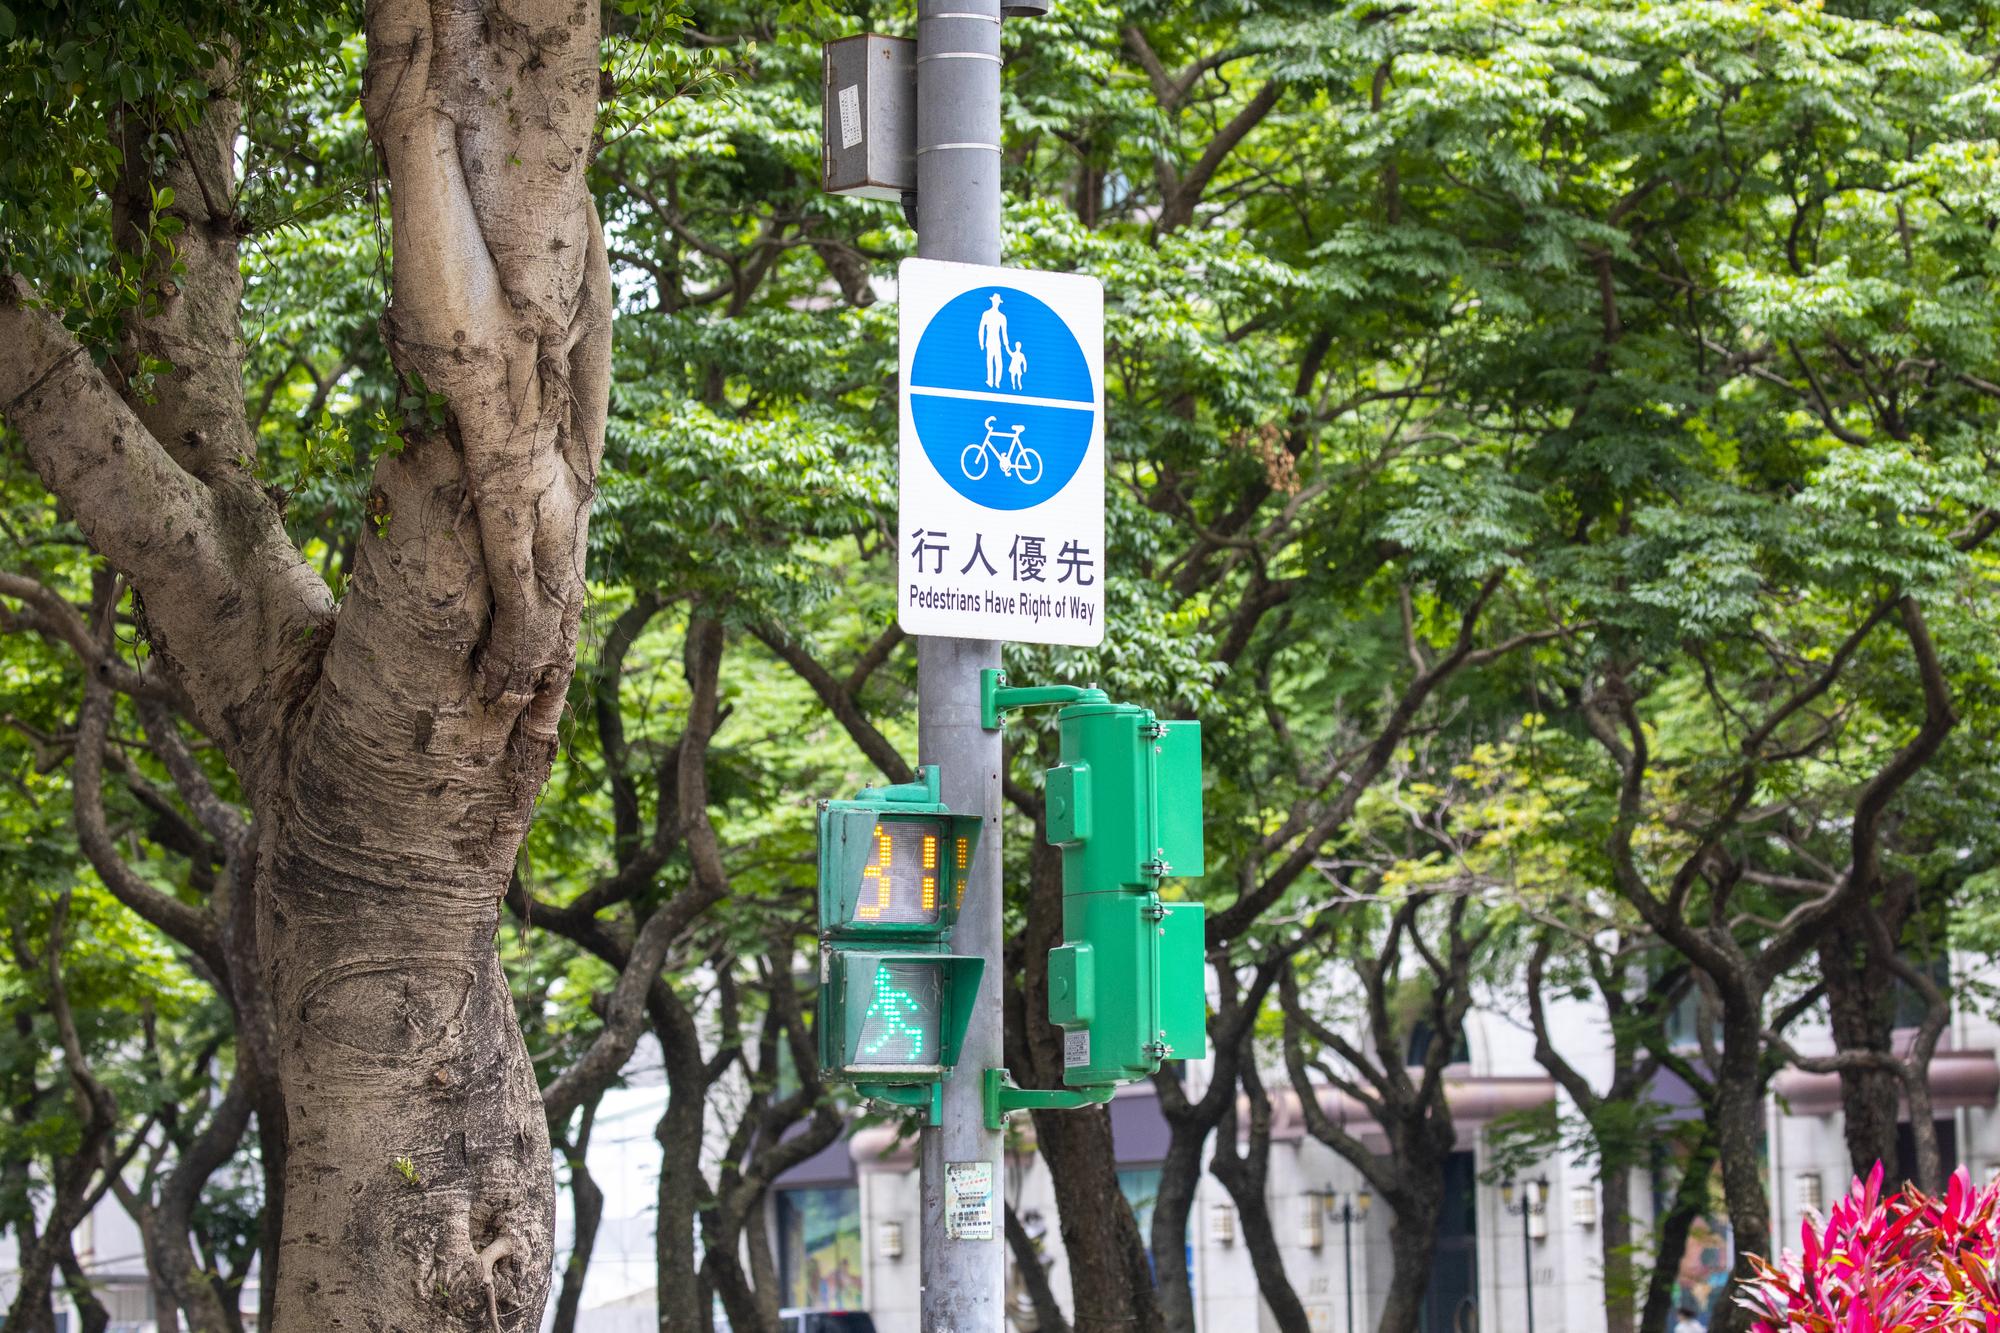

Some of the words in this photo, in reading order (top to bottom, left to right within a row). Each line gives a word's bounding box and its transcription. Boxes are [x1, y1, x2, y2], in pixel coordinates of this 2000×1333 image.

[911, 528, 1094, 585] 行人優先
[910, 584, 981, 612] Pedestrians
[984, 590, 1016, 615] Have
[1019, 592, 1052, 624] Right
[1055, 596, 1067, 618] of
[1069, 596, 1095, 626] Way
